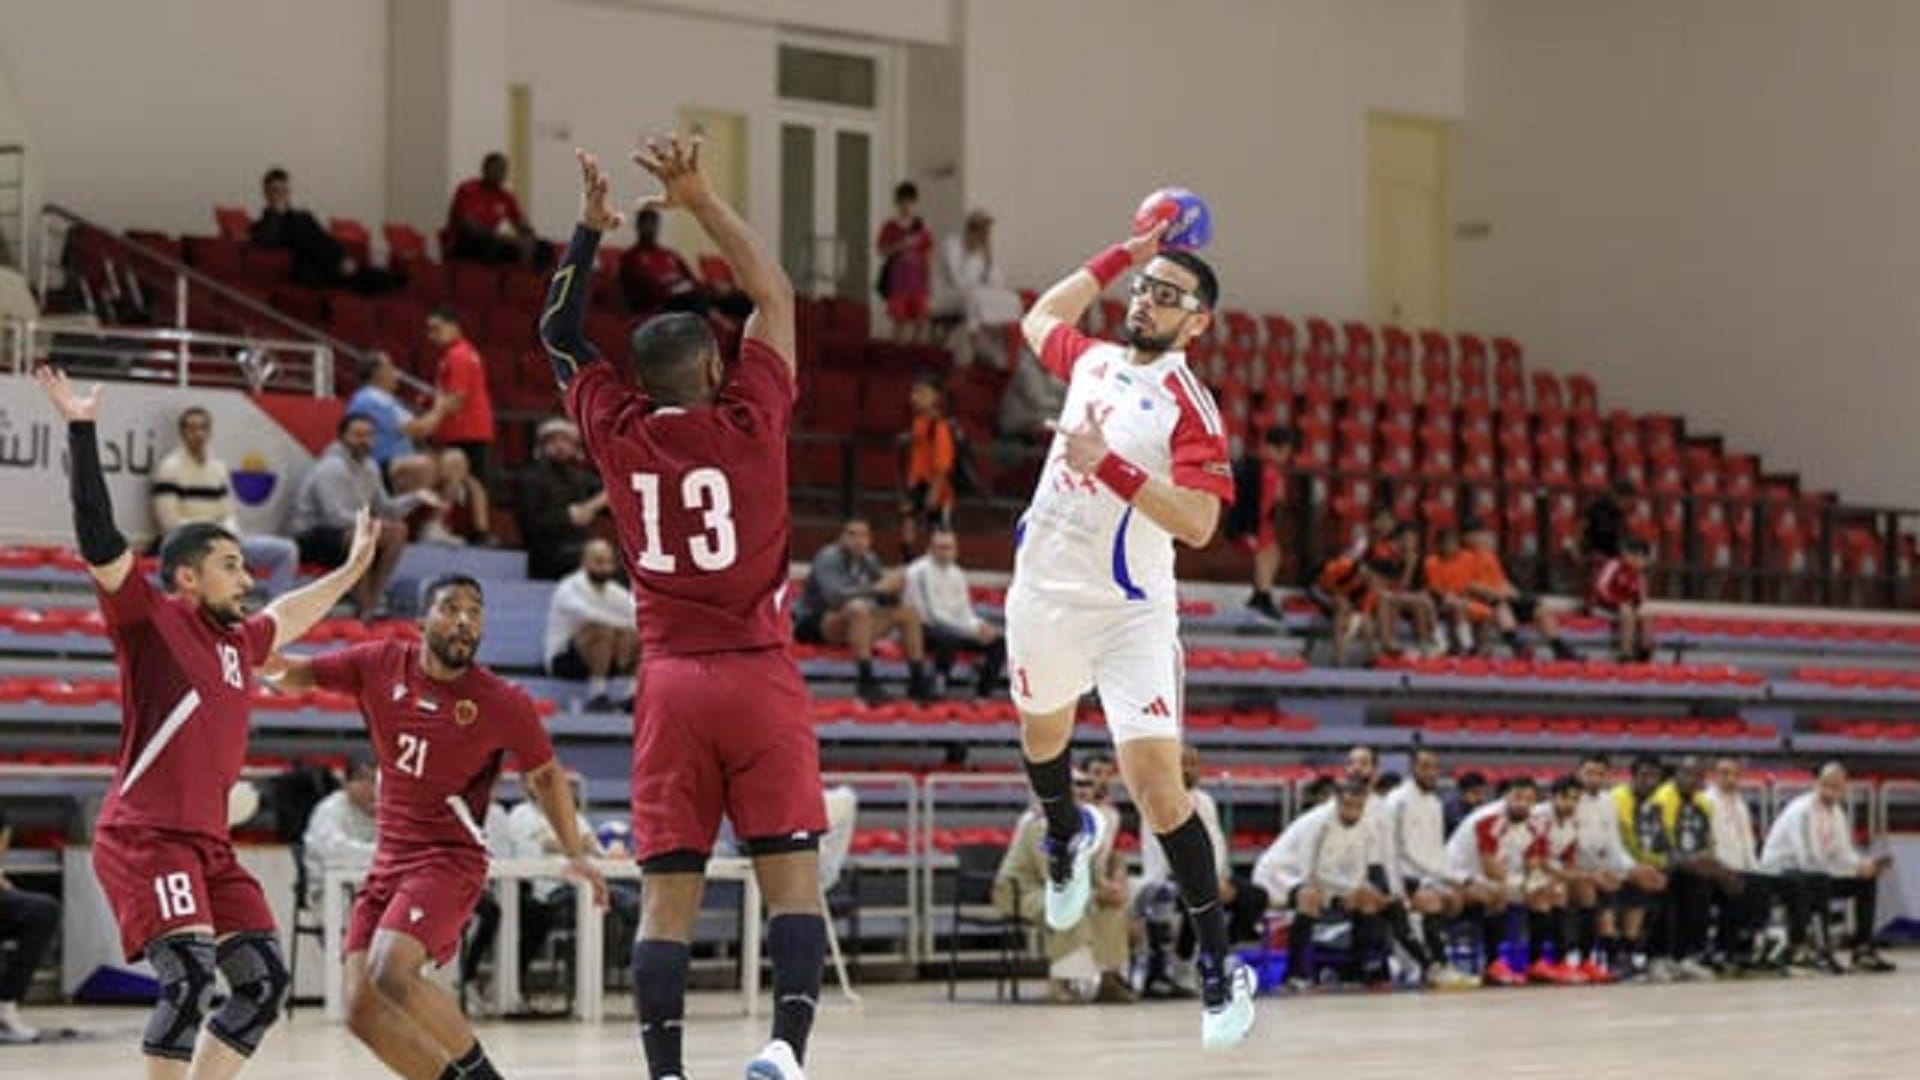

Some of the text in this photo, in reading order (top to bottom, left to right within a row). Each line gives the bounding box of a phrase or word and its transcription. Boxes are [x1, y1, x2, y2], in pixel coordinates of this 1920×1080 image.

[62, 428, 154, 478] ناد
[631, 467, 737, 573] 13
[215, 643, 243, 690] 18
[396, 733, 426, 777] 21
[155, 872, 196, 919] 18
